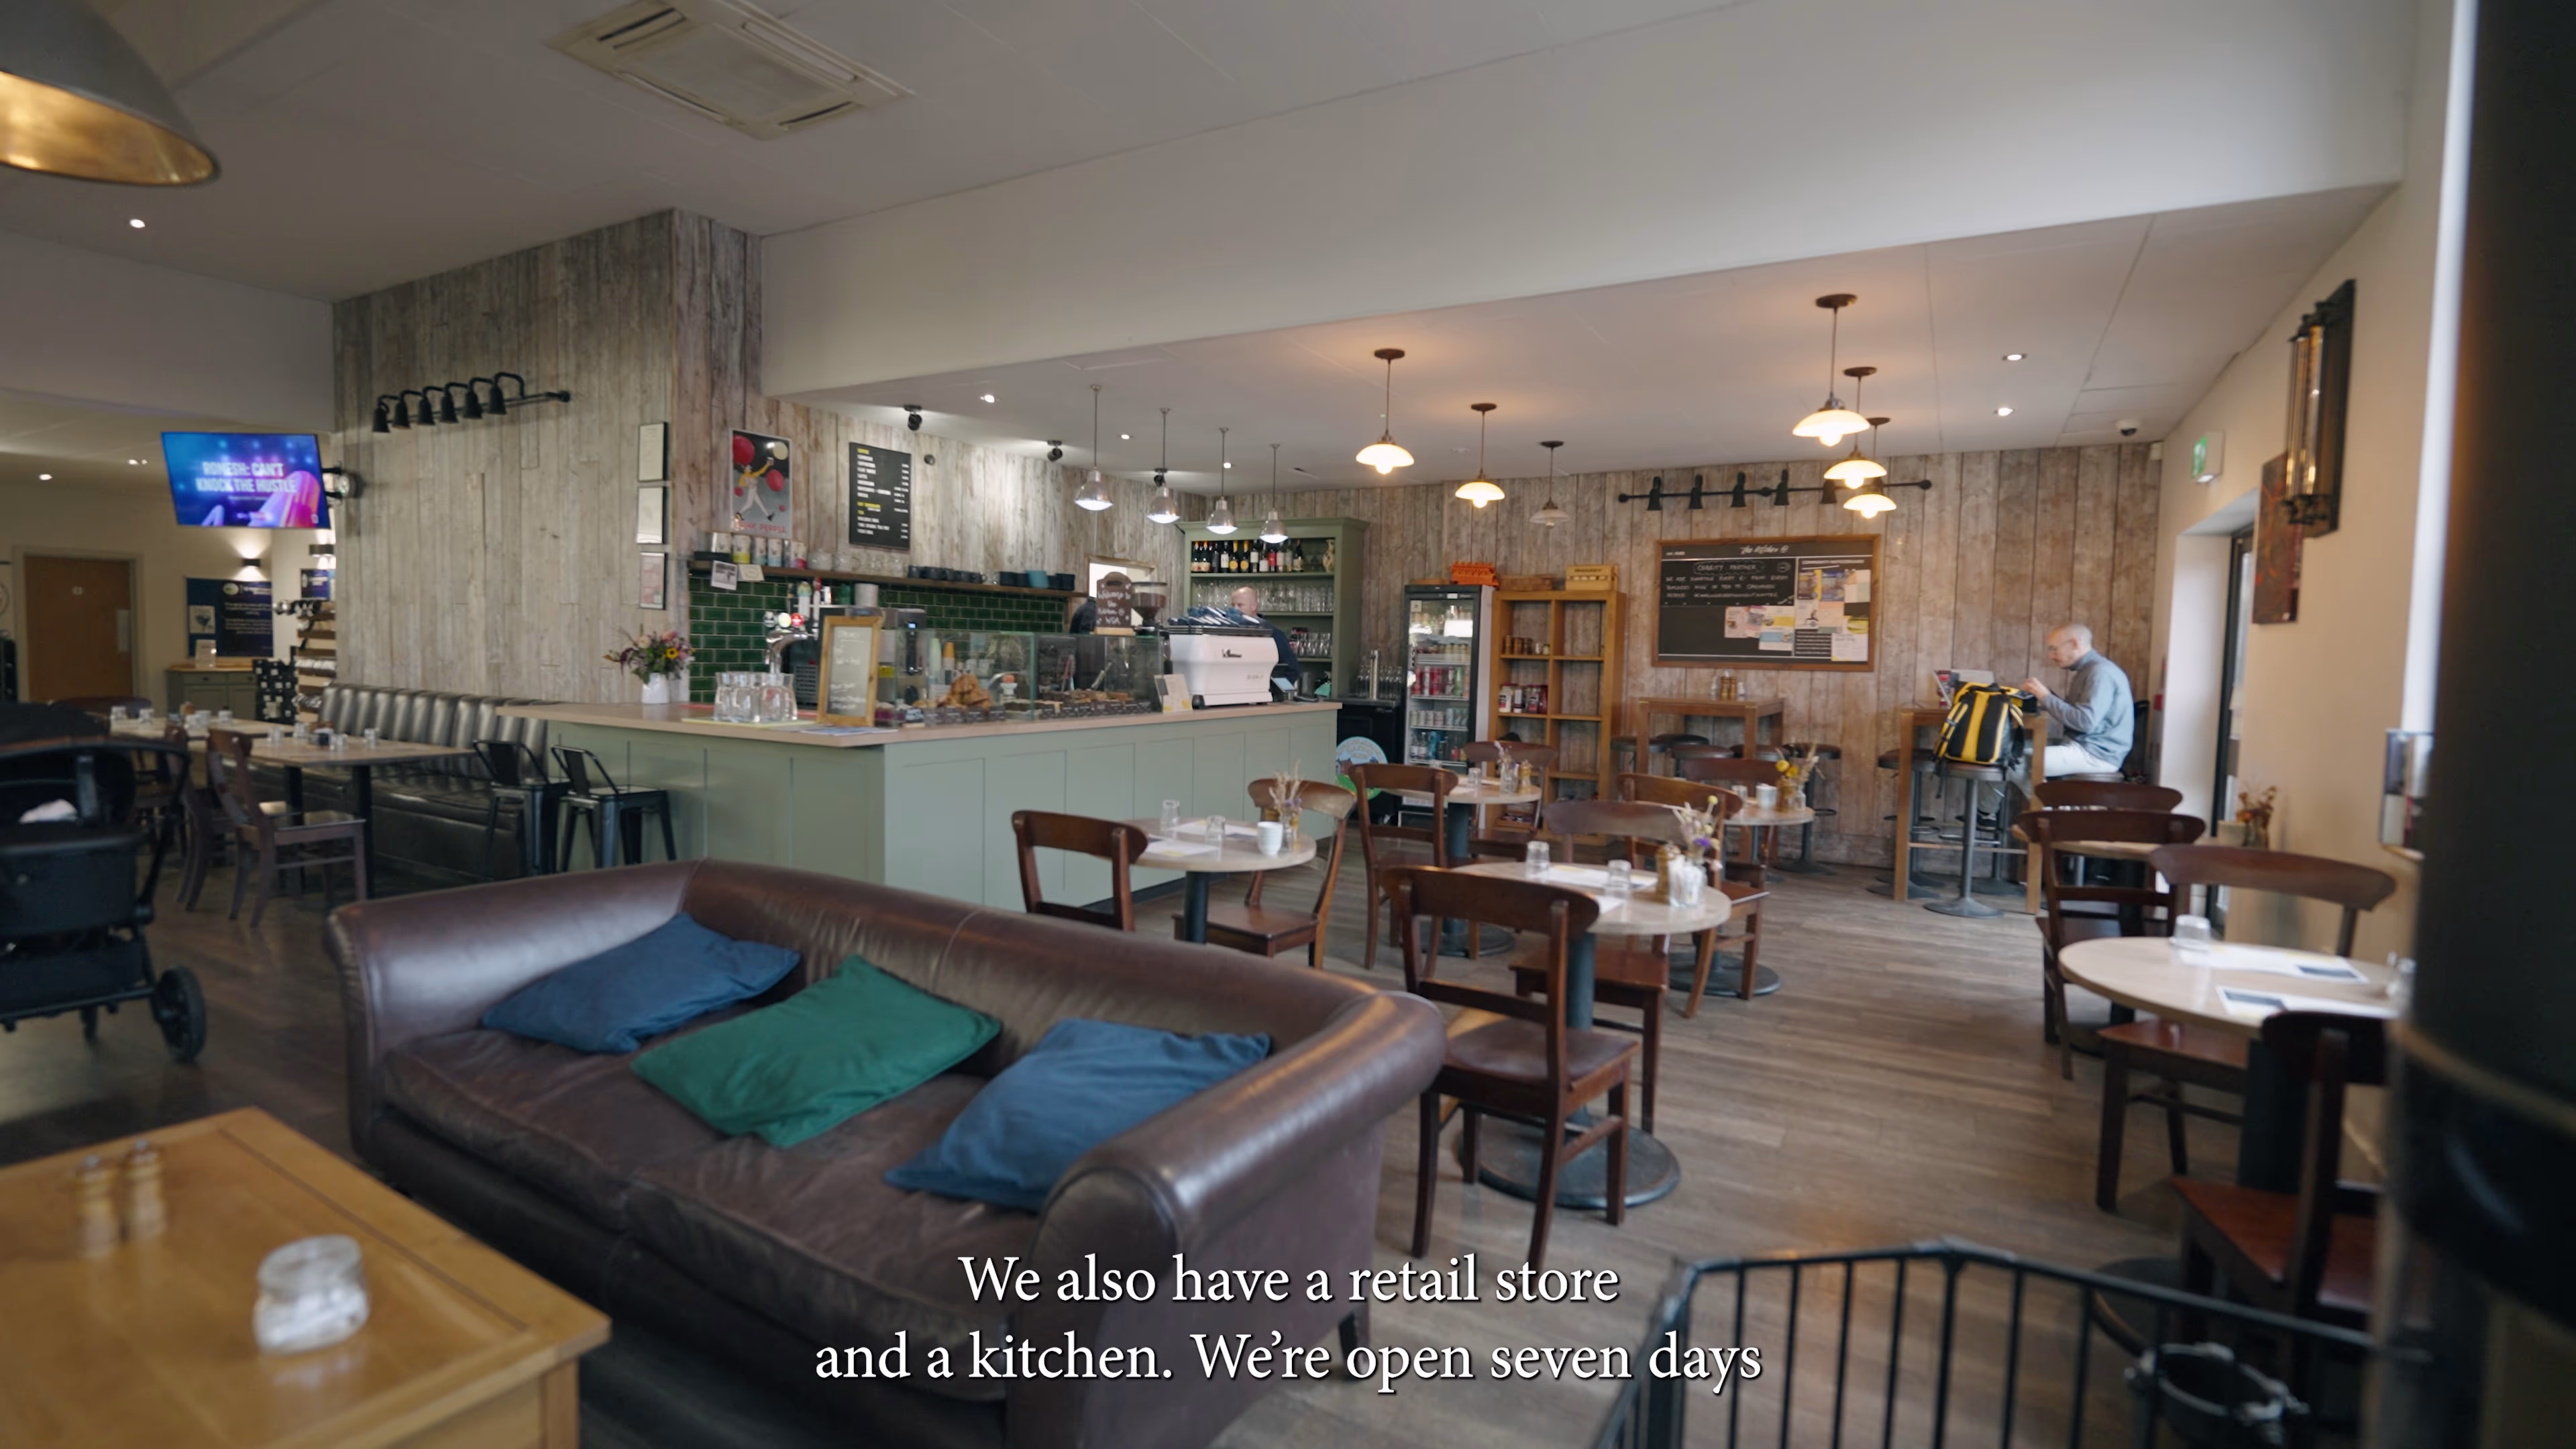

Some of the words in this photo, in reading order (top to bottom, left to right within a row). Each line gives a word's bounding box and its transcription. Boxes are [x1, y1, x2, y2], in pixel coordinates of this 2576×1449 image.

[252, 462, 284, 477] CAN'T
[197, 478, 233, 492] KNOCK
[233, 478, 256, 492] THE
[256, 479, 297, 493] HUSTLE
